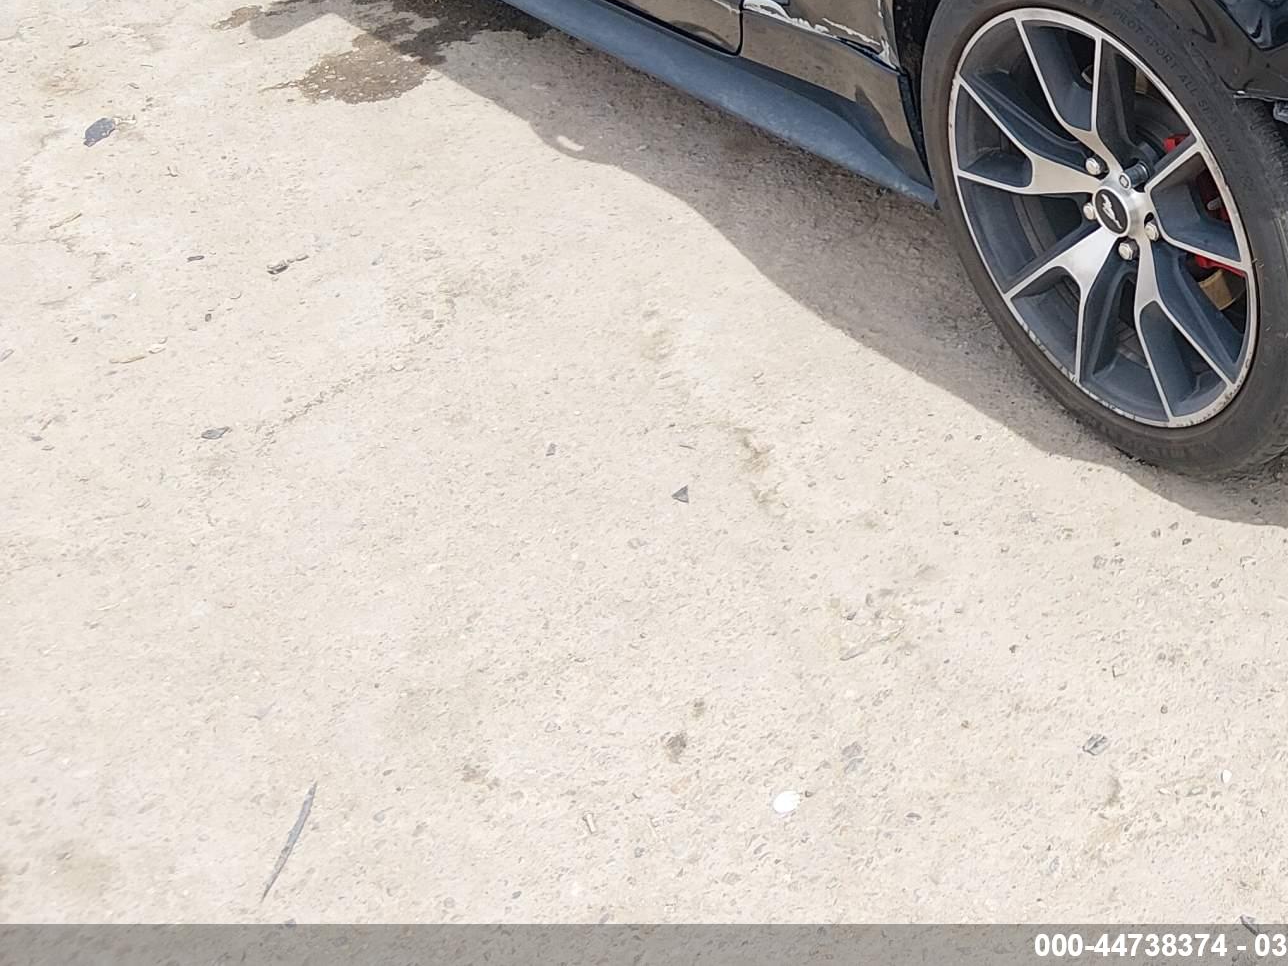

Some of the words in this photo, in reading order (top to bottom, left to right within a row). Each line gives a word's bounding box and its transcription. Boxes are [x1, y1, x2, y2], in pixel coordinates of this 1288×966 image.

[1112, 7, 1143, 36] PILOT
[1144, 33, 1177, 70] SPORT
[1177, 70, 1199, 97] ALL
